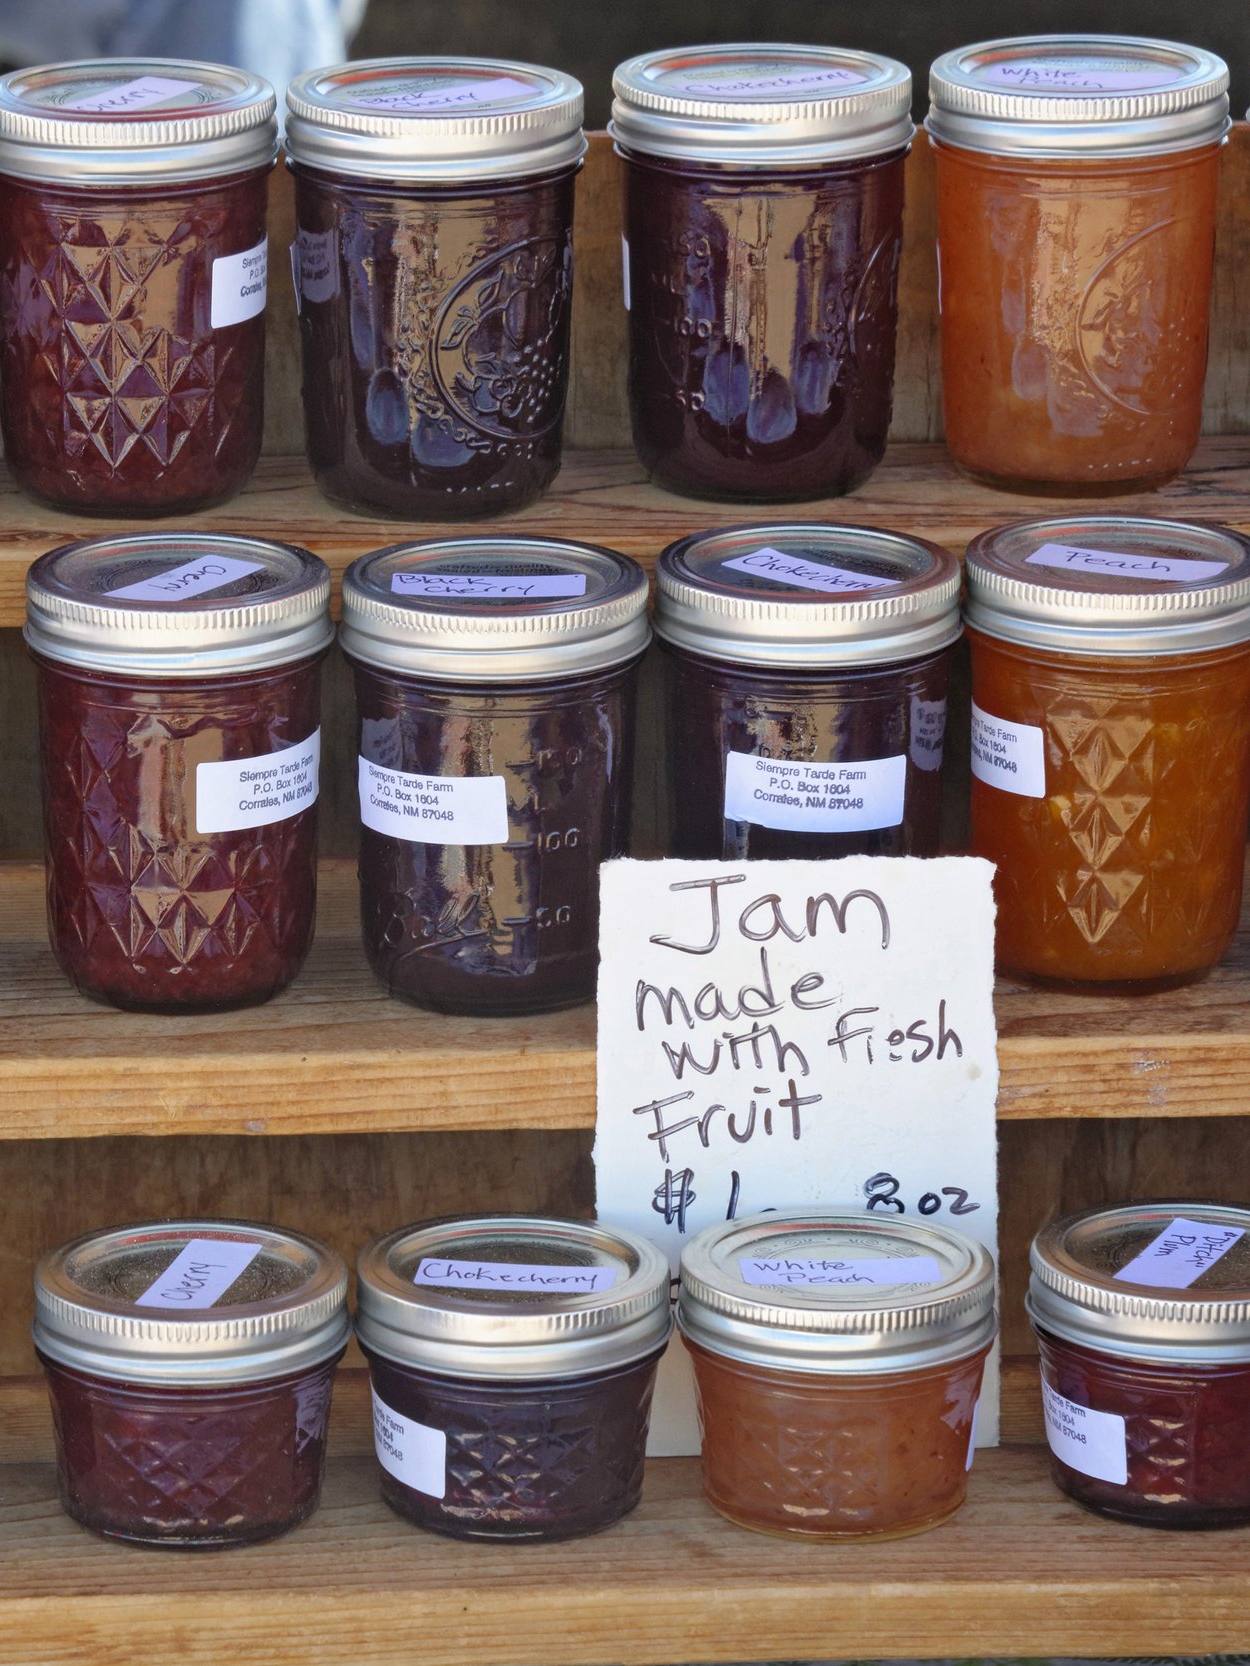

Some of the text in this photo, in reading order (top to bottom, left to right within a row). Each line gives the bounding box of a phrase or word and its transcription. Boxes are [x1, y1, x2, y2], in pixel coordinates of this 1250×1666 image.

[1066, 550, 1171, 573] Peach
[396, 574, 491, 585] Black
[425, 584, 535, 596] Cherry
[997, 729, 1018, 743] Farm
[239, 768, 278, 783] Siempre
[280, 762, 300, 775] Tarde
[368, 765, 454, 792] Siempre Tarde Farm
[755, 761, 867, 780] Siempre Tarde Farm
[253, 783, 274, 795] P.O.
[276, 779, 291, 790] Box
[376, 783, 393, 797] P.O.
[395, 789, 412, 801] Box
[769, 778, 794, 790] P.O.
[797, 781, 819, 794] Box
[283, 790, 296, 803] NM
[753, 789, 864, 809] Corrales, NM 87048
[403, 805, 420, 817] NM
[422, 808, 454, 821] 87048
[649, 873, 890, 955] Jam
[635, 946, 844, 1031] made
[661, 1020, 810, 1080] with
[632, 1079, 823, 1164] Fruit
[753, 1259, 854, 1271] White
[160, 1261, 228, 1301] Cherry
[422, 1262, 598, 1290] Chokecherry
[778, 1272, 875, 1284] Peach
[1065, 1401, 1086, 1418] Farm
[1063, 1427, 1087, 1444] 87048
